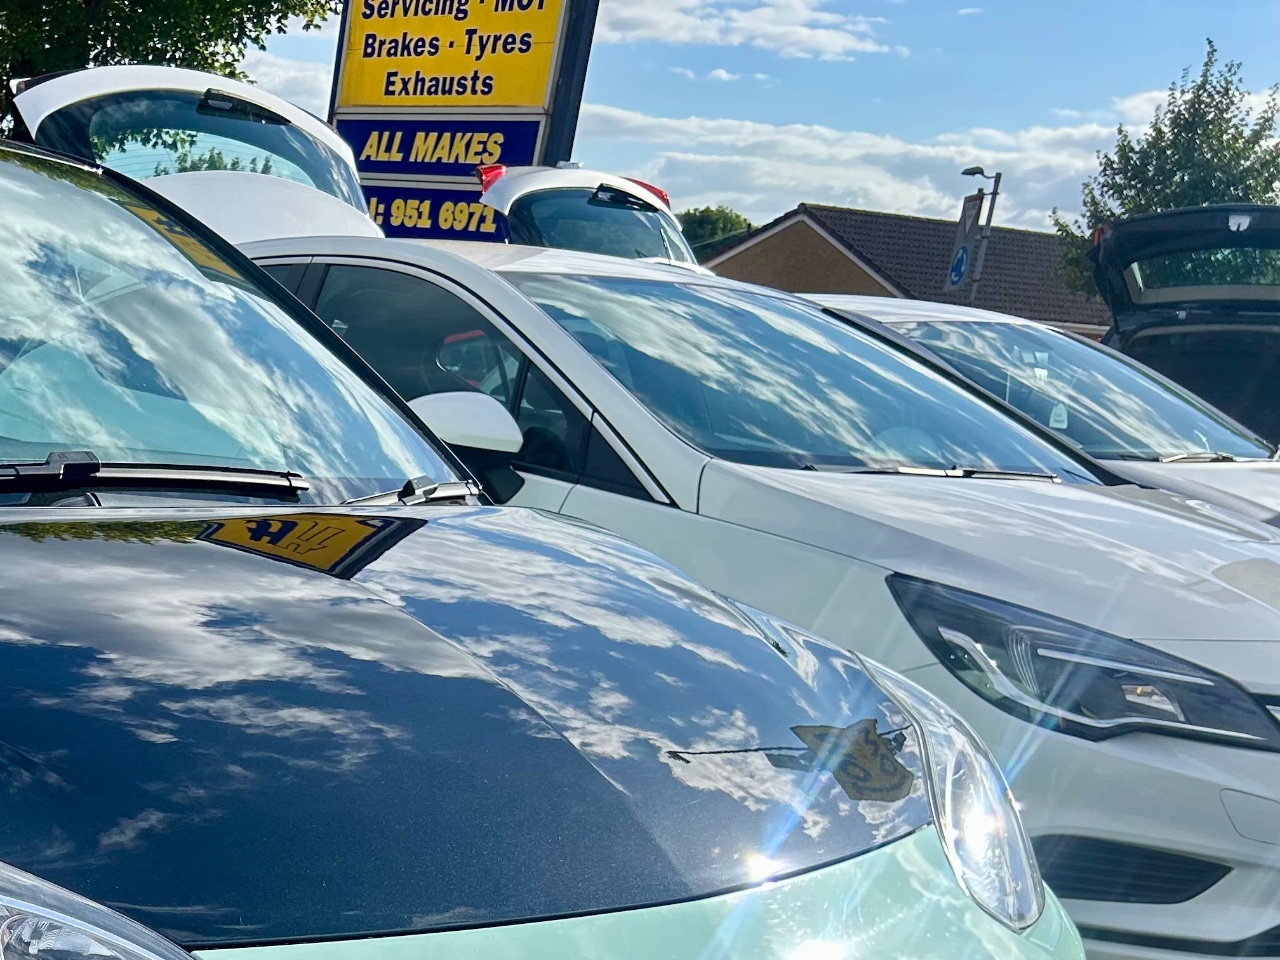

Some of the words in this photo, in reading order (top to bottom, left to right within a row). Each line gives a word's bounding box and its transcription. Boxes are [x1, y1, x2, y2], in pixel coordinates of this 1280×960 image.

[361, 0, 469, 21] Servicing
[362, 32, 440, 58] Brakes
[465, 28, 533, 61] Tyres
[384, 70, 494, 97] Exhausts
[360, 131, 404, 162] ALL
[409, 132, 504, 165] MAKES
[390, 199, 431, 228] 951
[438, 201, 497, 233] 6971
